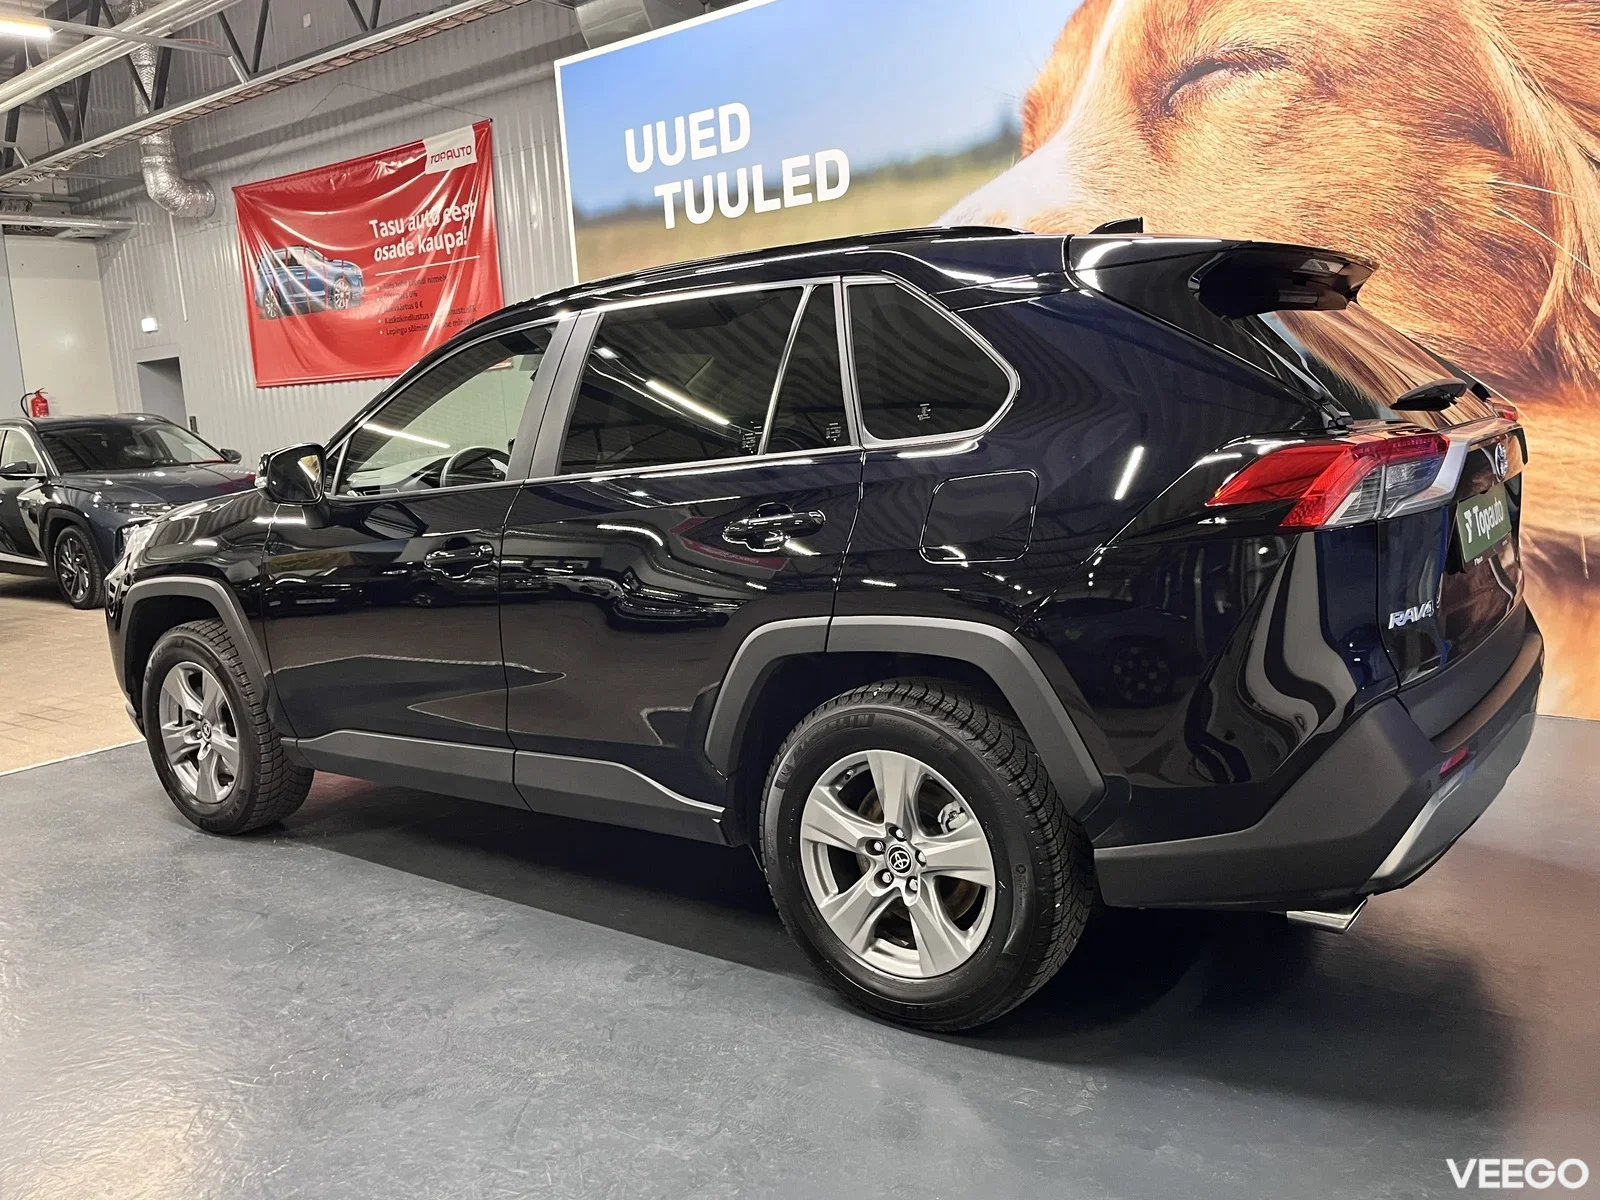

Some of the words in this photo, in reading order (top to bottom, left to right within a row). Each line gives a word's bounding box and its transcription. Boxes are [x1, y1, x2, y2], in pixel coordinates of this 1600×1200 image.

[430, 145, 472, 164] TOPAUTO
[625, 102, 751, 173] UUED
[653, 149, 850, 230] TUULED
[369, 218, 405, 238] Tasu
[407, 209, 440, 232] auto
[443, 202, 476, 224] eest
[374, 237, 415, 262] osade
[417, 226, 467, 255] kaupa!
[1472, 496, 1504, 540] Topauto
[1388, 600, 1435, 630] RAV4
